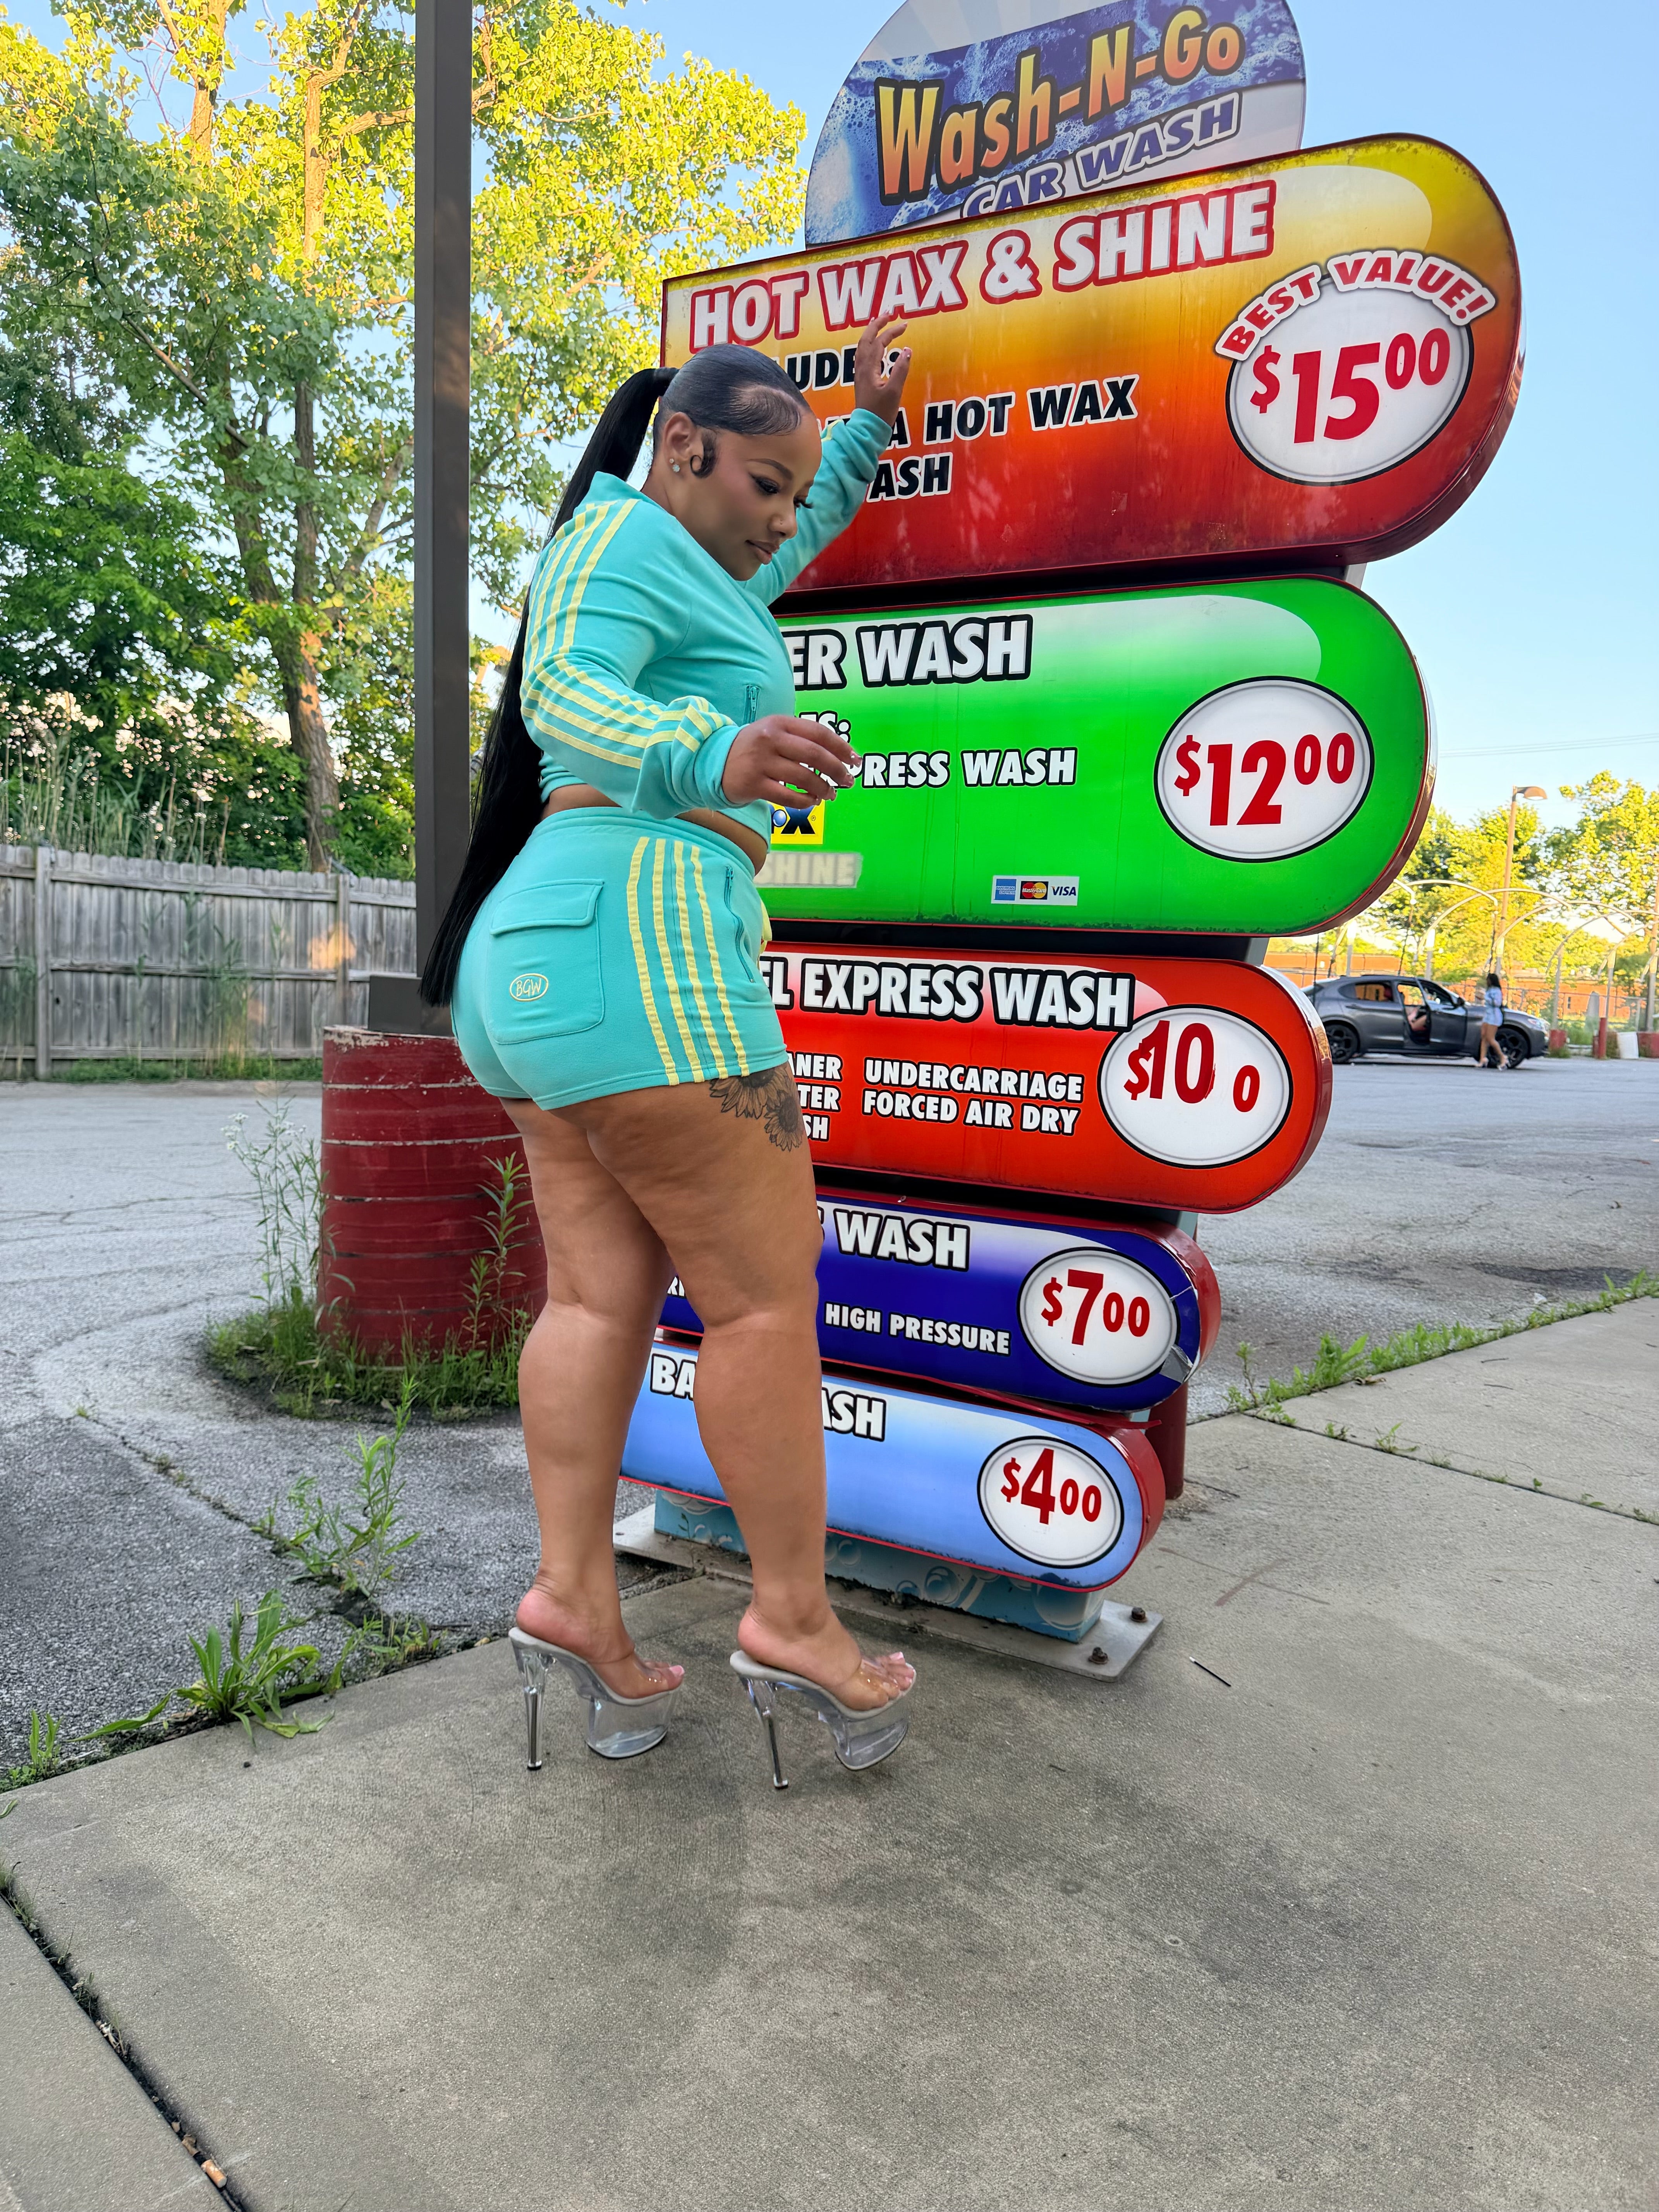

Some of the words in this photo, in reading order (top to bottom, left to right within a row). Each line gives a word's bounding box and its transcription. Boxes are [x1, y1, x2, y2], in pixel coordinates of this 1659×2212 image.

[878, 9, 1242, 198] Wash-N-Go
[966, 167, 1062, 217] CAR
[1082, 96, 1236, 184] WASH
[694, 273, 806, 348] HOT
[818, 243, 967, 326] WAX
[985, 232, 1036, 299] &
[1057, 184, 1272, 287] SHINE
[1221, 271, 1321, 355] BEST
[1333, 256, 1489, 320] VALUE!
[926, 394, 1012, 445] HOT
[1030, 376, 1137, 428] WAX
[860, 619, 1029, 682] WASH
[962, 749, 1076, 785] WASH
[1051, 886, 1077, 896] VISA
[516, 977, 541, 997] BGW
[804, 962, 980, 1018] EXPRESS
[993, 972, 1131, 1027] WASH
[865, 1059, 1083, 1101] UNDERCARRIAGE
[864, 1091, 957, 1121] FORCED
[965, 1100, 1012, 1128] AIR
[1021, 1107, 1080, 1135] DRY
[835, 1210, 968, 1270] WASH
[826, 1303, 881, 1333] HIGH
[890, 1315, 1010, 1355] PRESSURE
